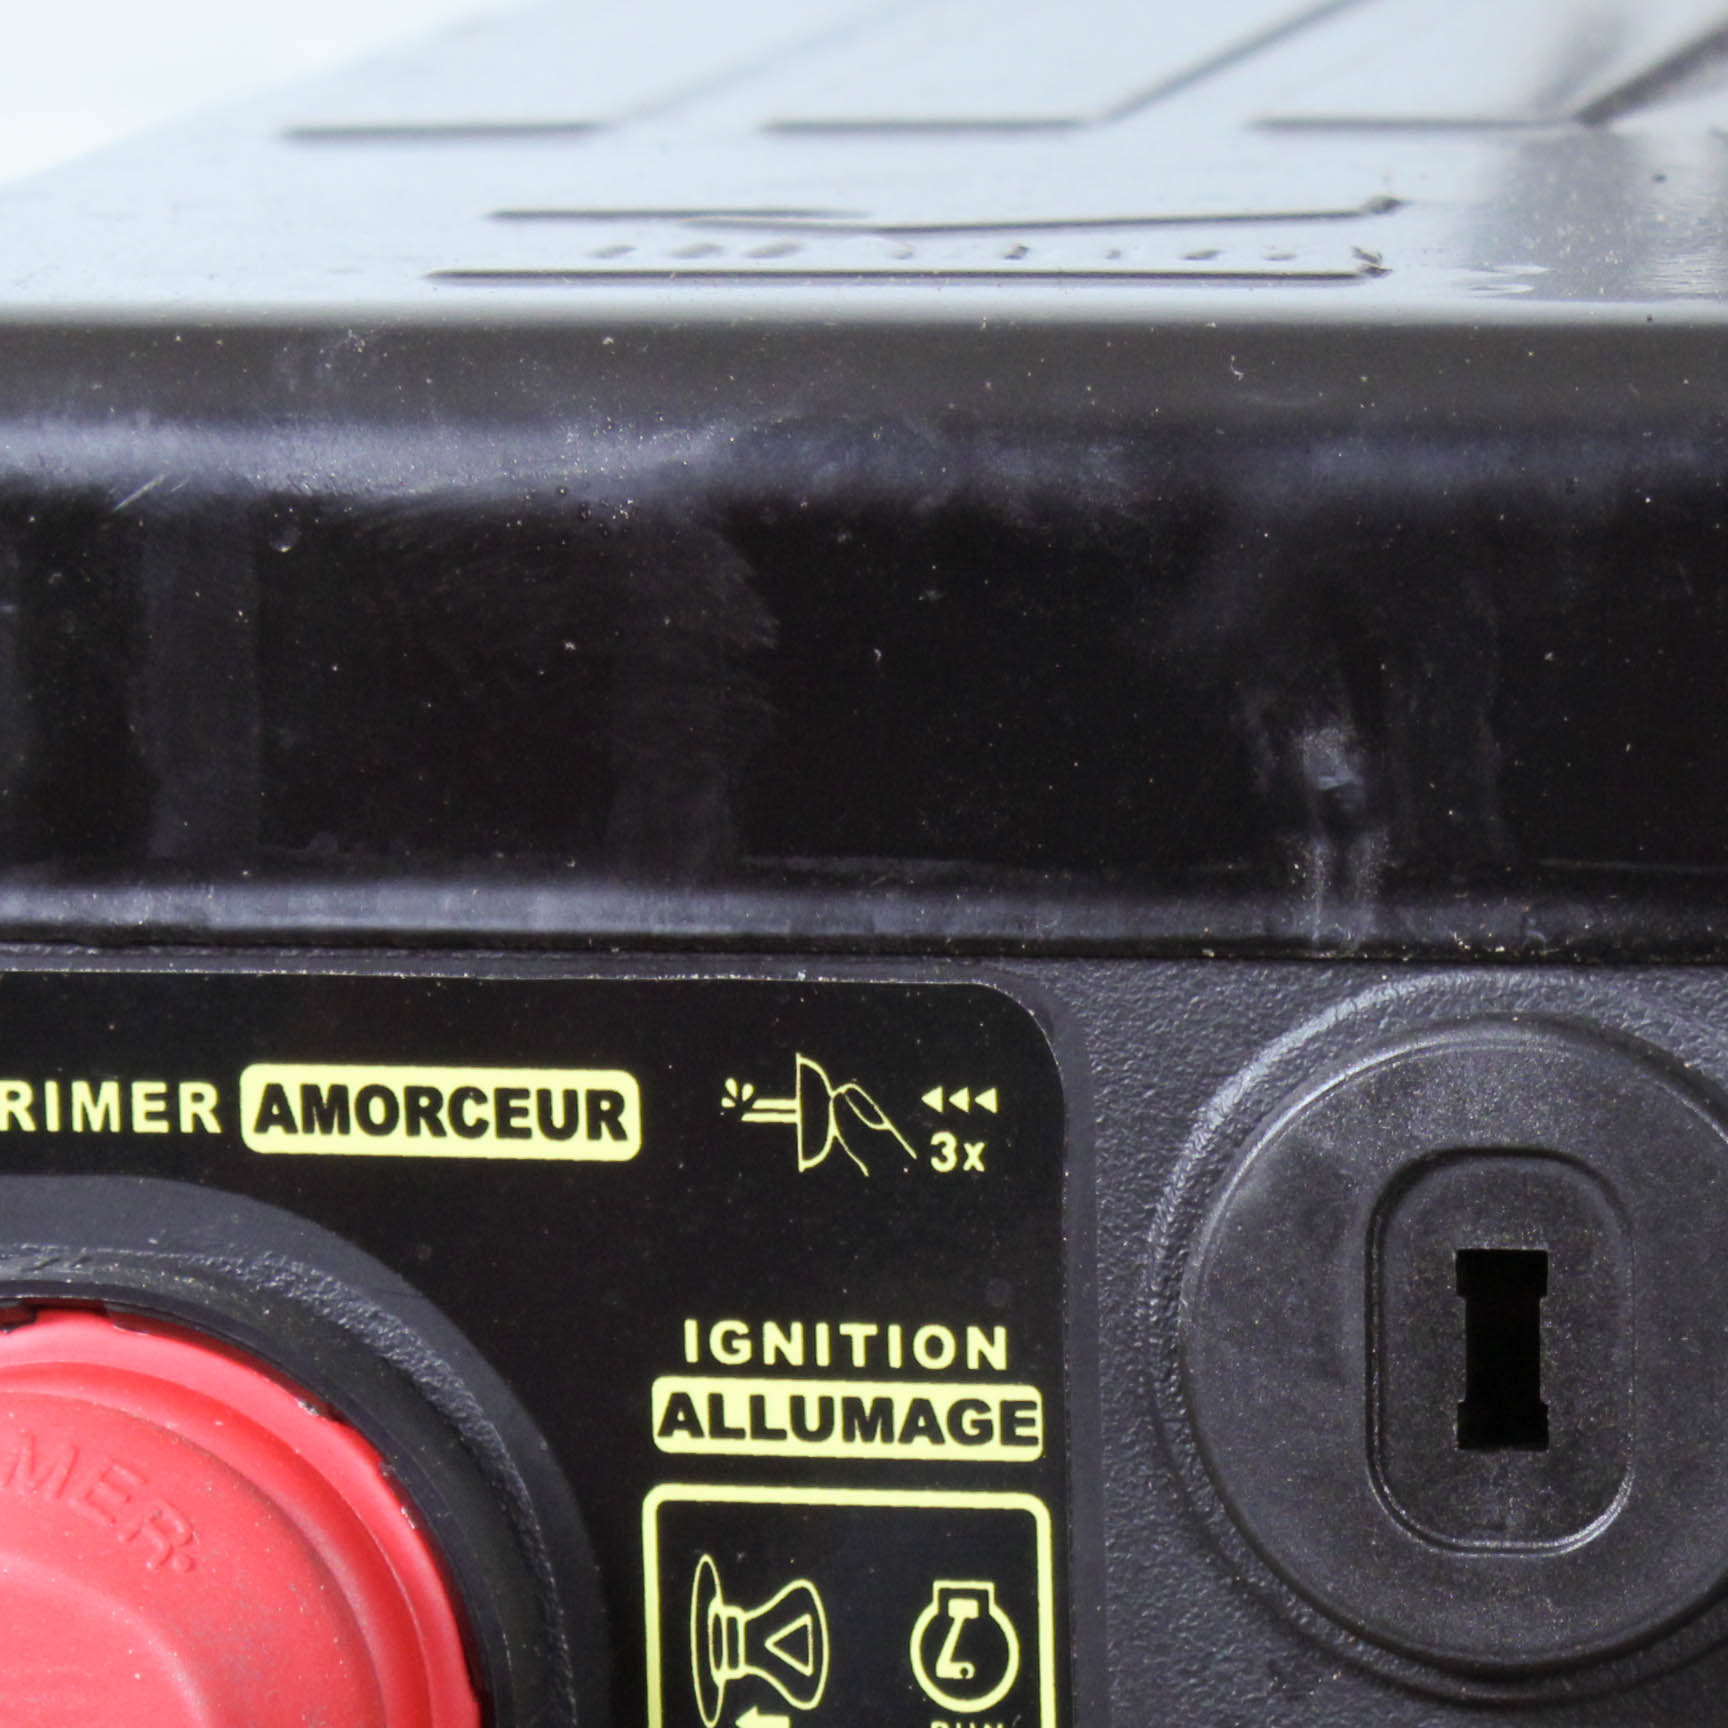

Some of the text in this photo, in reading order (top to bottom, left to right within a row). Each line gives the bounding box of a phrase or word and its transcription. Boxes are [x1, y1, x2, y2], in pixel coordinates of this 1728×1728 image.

[254, 1082, 628, 1142] AMORCEUR
[930, 1131, 986, 1174] 3x
[683, 1317, 1008, 1371] IGNITION
[658, 1391, 1040, 1448] ALLUMAGE
